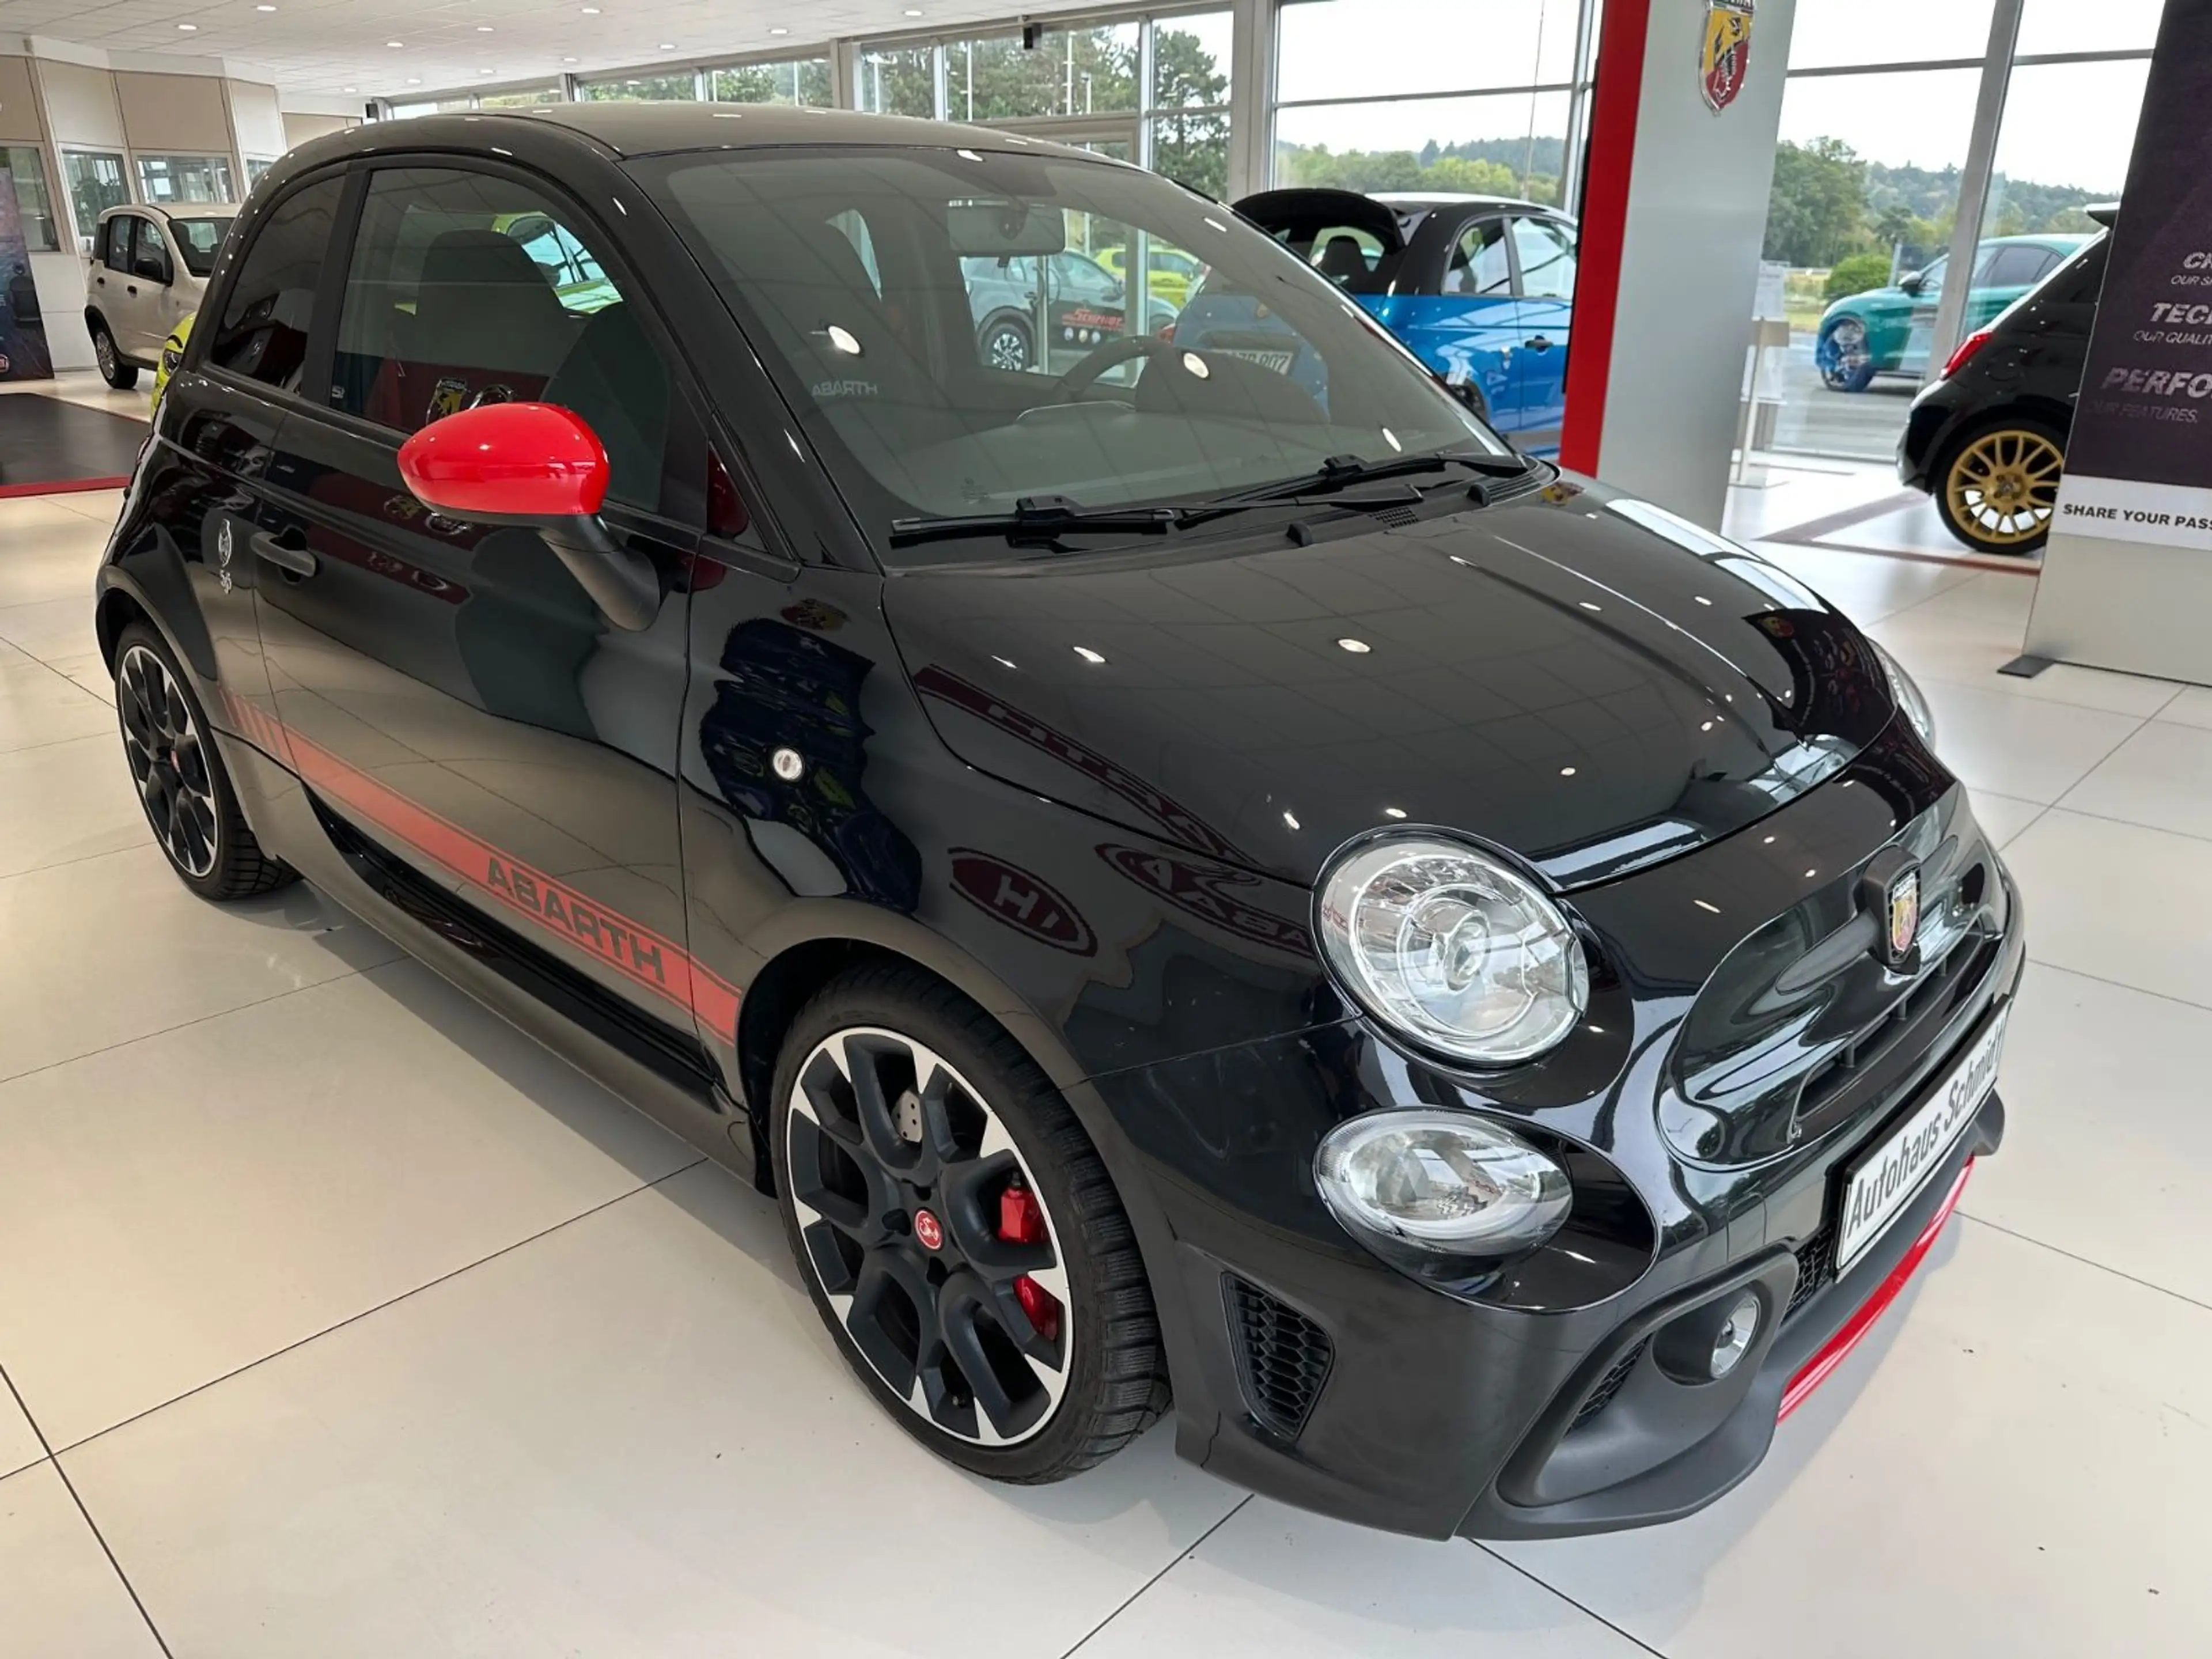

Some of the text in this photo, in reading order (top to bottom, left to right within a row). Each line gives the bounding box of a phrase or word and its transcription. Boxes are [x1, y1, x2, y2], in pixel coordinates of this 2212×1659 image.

[2170, 275, 2199, 286] OUR
[2101, 366, 2212, 398] PERFO
[2063, 503, 2118, 519] SHARE
[2122, 509, 2170, 525] YOUR
[487, 856, 666, 983] ABARTH
[1847, 1112, 1942, 1239] Autohaus
